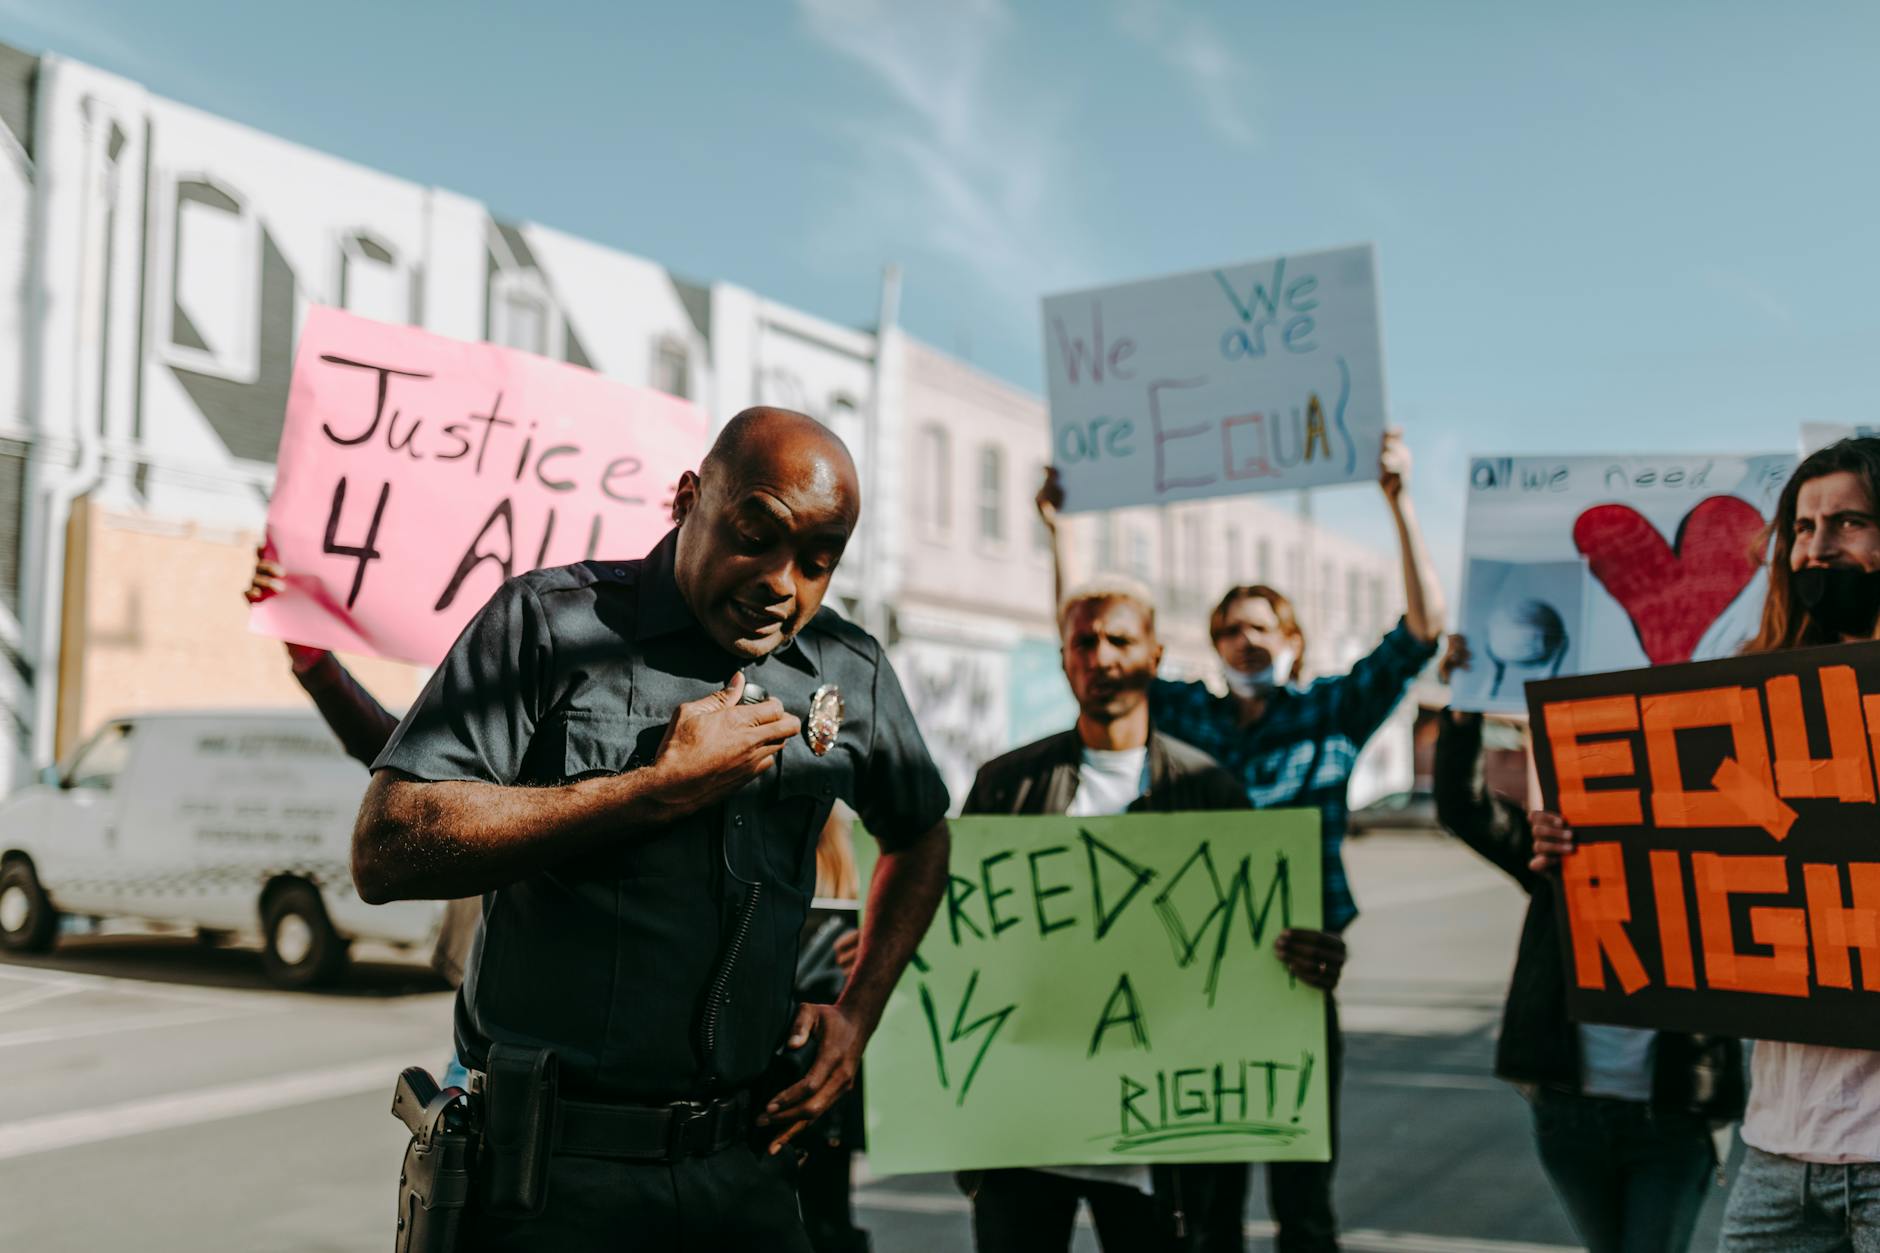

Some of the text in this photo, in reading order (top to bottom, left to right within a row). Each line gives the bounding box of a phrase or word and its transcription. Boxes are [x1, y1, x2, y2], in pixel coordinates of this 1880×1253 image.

[1213, 256, 1320, 323] We
[1053, 300, 1137, 385] We
[1220, 314, 1319, 361] are
[319, 354, 646, 505] Justice
[1058, 415, 1136, 464] are
[1520, 465, 1570, 492] we
[1604, 460, 1714, 491] need
[322, 475, 390, 610] 4
[1543, 664, 1880, 842] EQU
[947, 827, 1296, 1009] REEDOM
[1088, 972, 1151, 1058] A
[1119, 1050, 1314, 1136] RIGHT!
